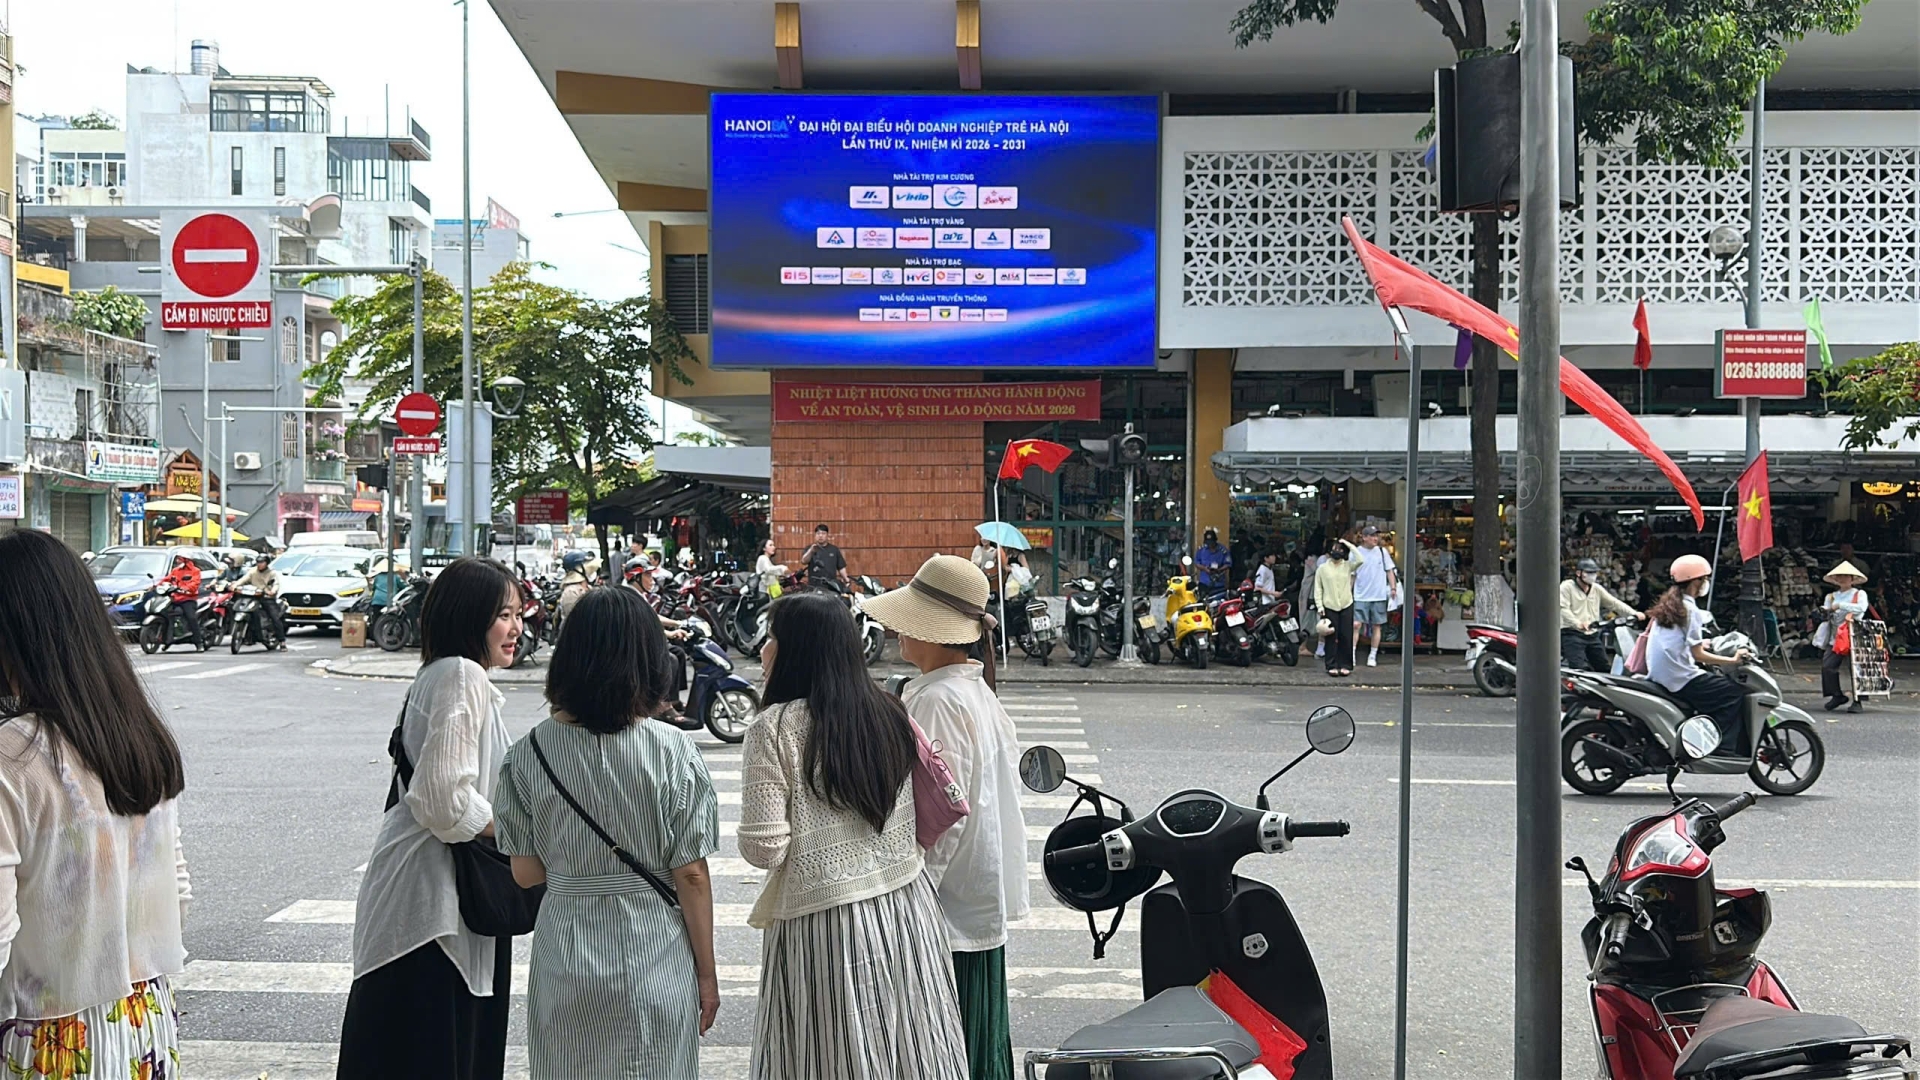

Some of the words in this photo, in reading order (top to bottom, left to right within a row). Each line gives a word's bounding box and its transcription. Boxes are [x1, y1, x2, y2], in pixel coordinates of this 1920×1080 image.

[800, 122, 818, 134] ĐẠI
[822, 118, 840, 135] HỘI
[844, 122, 863, 135] ĐẠI
[866, 118, 892, 132] BIỂU
[896, 120, 914, 135] HỘI
[918, 122, 957, 133] DOANH
[960, 120, 1002, 135] NGHIỆP
[1006, 120, 1027, 133] TRẺ
[1030, 120, 1046, 133] HÀ
[1050, 120, 1069, 135] NỘI
[842, 134, 865, 149] LẦN
[868, 136, 892, 149] THỨ
[895, 139, 909, 150] IX,
[912, 137, 948, 152] NHIỆM
[951, 137, 962, 149] KÌ
[966, 140, 990, 150] 2026
[1002, 140, 1026, 150] 2031
[893, 173, 908, 181] NHÀ
[922, 174, 934, 182] TRỢ
[903, 216, 918, 224] NHÀ
[946, 216, 965, 225] VÀNG
[948, 259, 962, 267] BẠC
[164, 303, 186, 323] CẤM
[189, 308, 199, 323] ĐI
[202, 307, 236, 325] NGƯỢC
[238, 302, 268, 323] CHIỀU
[1725, 362, 1804, 379] 0236.3888888
[790, 386, 833, 400] NHIỆT
[836, 386, 867, 400] LIỆT
[870, 385, 918, 399] HƯỞNG
[922, 386, 950, 398] ỨNG
[954, 386, 1001, 398] THÁNG
[1005, 386, 1043, 398] HÀNH
[1048, 384, 1086, 400] ĐỘNG
[801, 402, 818, 416] VỀ
[821, 406, 840, 416] AN
[843, 403, 884, 417] TOÀN,
[886, 403, 904, 417] VỆ
[907, 406, 940, 415] SINH
[944, 406, 970, 415] LAO
[974, 402, 1012, 417] ĐỘNG
[1015, 403, 1045, 415] NĂM
[1048, 405, 1075, 415] 2026
